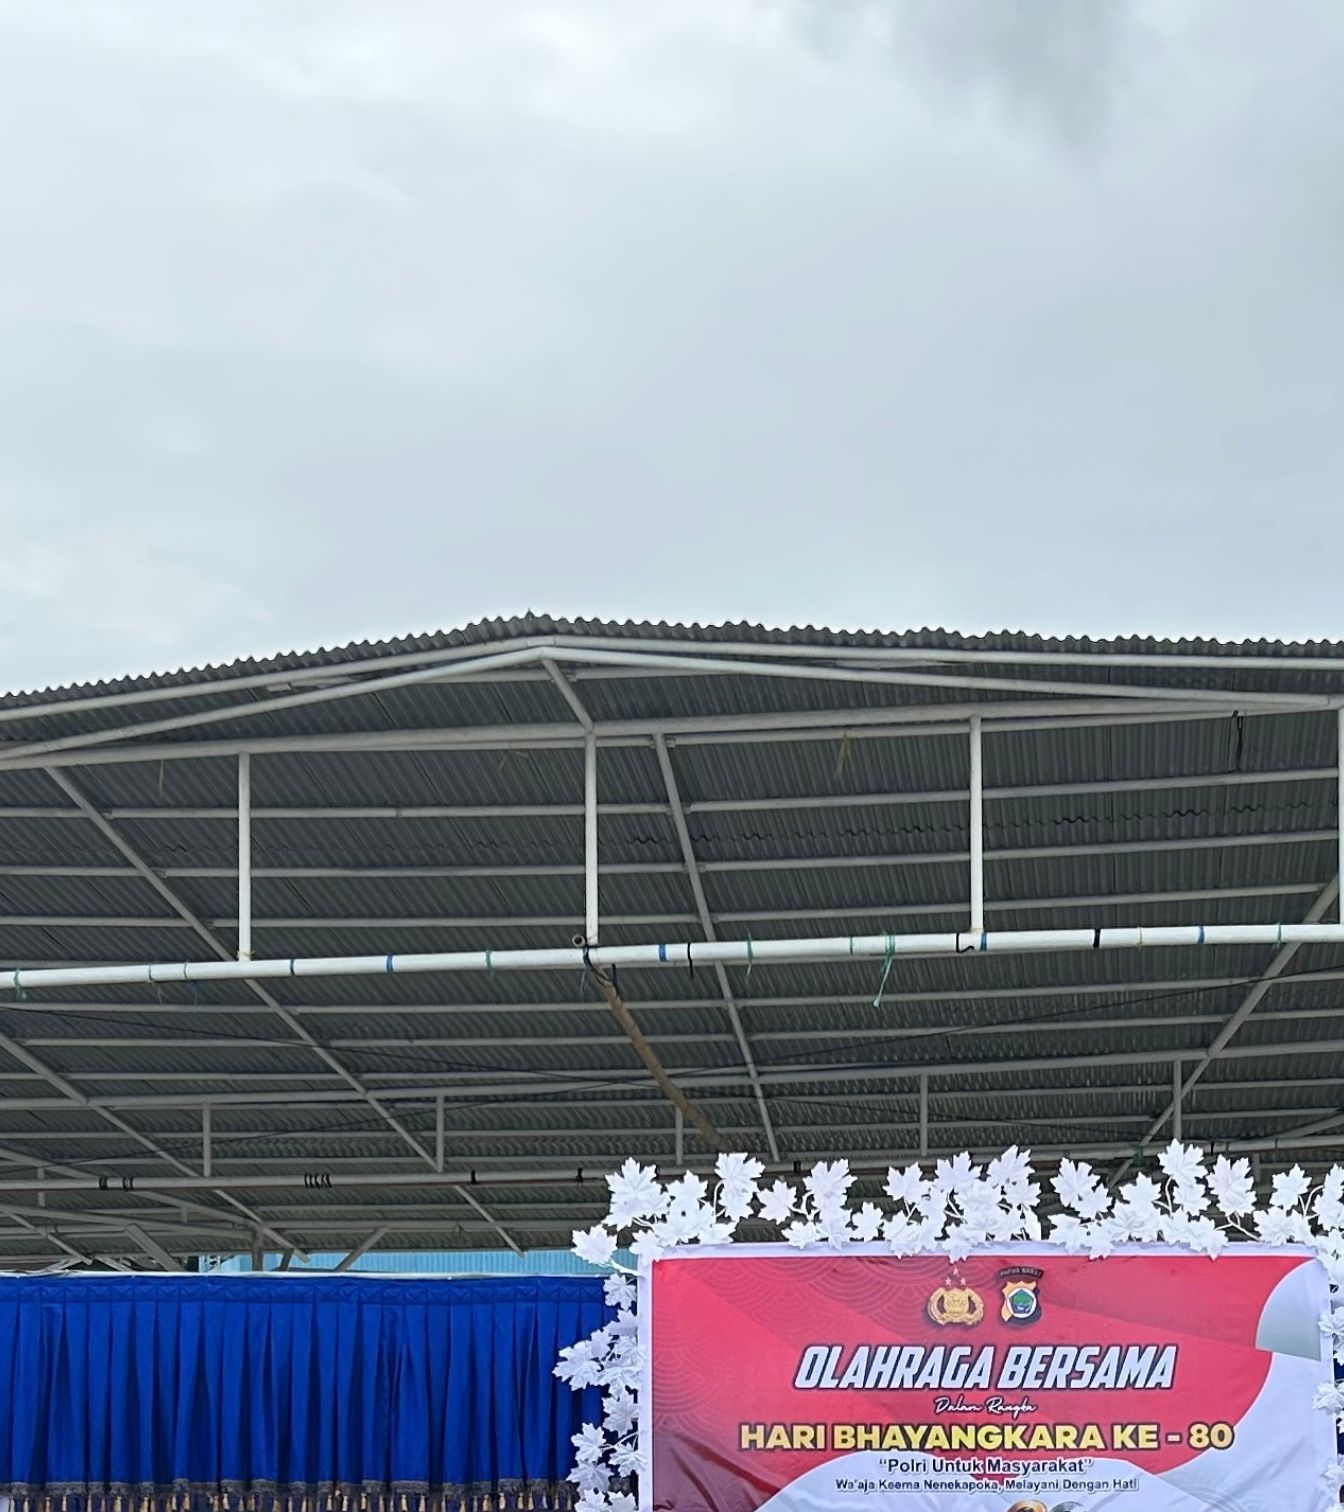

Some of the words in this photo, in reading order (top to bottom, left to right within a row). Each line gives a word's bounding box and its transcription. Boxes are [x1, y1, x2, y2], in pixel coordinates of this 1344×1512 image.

[794, 1345, 995, 1389] OLAHRAGA
[996, 1345, 1177, 1389] BERSAMA
[935, 1394, 983, 1414] Dalam
[985, 1396, 1037, 1420] Rangka
[740, 1424, 826, 1449] HARI
[833, 1424, 1106, 1450] BHAYANGKARA
[1112, 1424, 1159, 1449] KE
[1167, 1433, 1181, 1442] -
[1189, 1422, 1233, 1449] 80
[932, 1458, 984, 1473] Untuk
[1005, 1479, 1059, 1492] Melayani
[1062, 1479, 1110, 1492] Dengan
[1112, 1479, 1138, 1490] Hati
